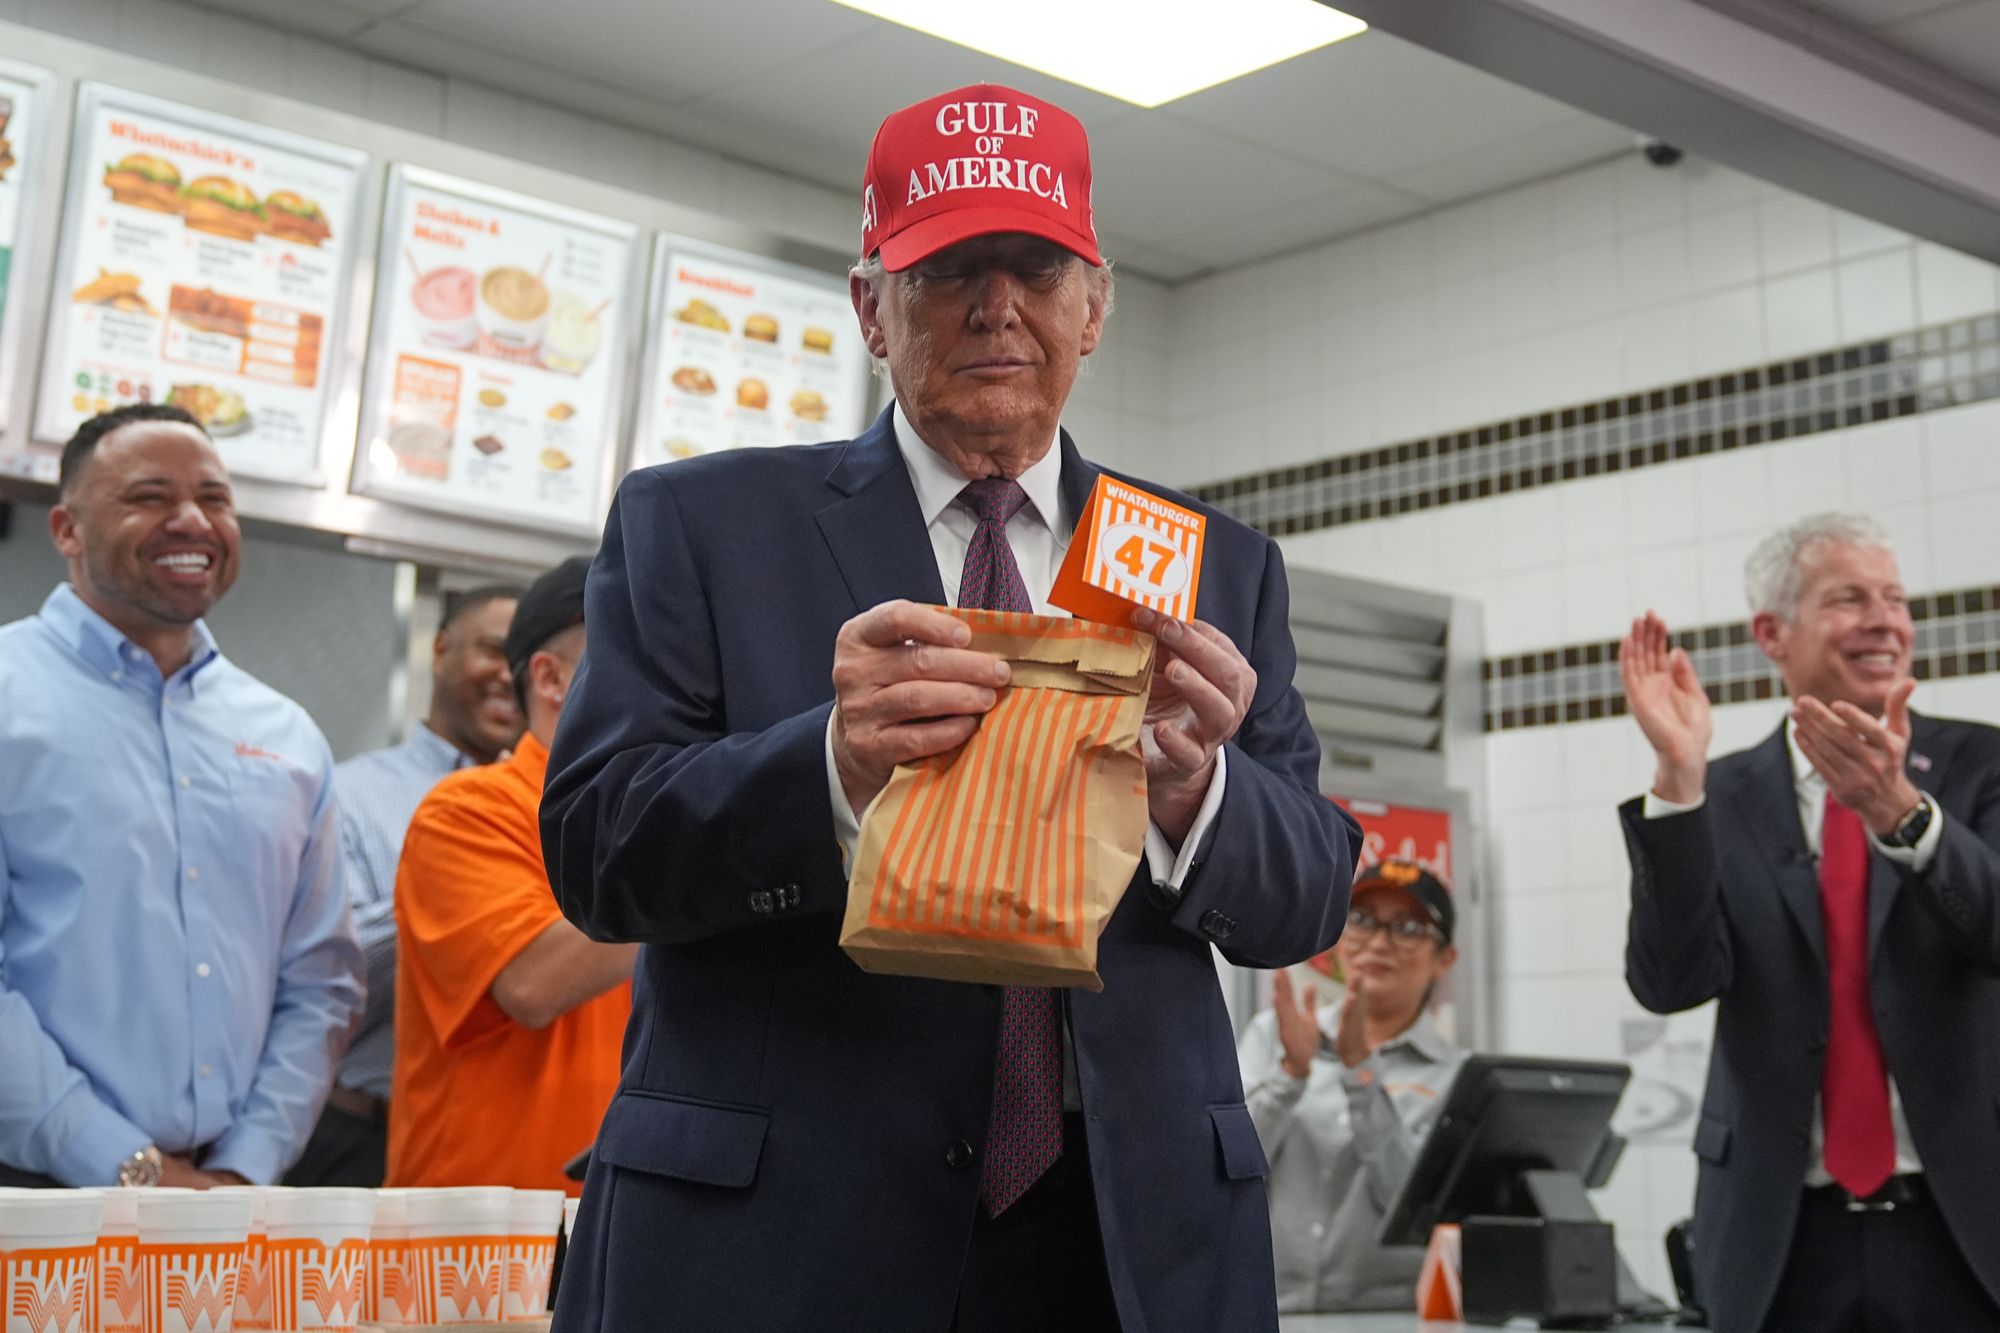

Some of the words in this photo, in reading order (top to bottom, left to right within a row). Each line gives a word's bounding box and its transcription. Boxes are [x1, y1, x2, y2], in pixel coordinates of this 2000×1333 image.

[936, 102, 1039, 138] GULF
[975, 136, 1004, 154] OF
[906, 157, 1068, 209] AMERICA
[1106, 483, 1200, 530] WHATABURGER
[1115, 535, 1176, 587] 47
